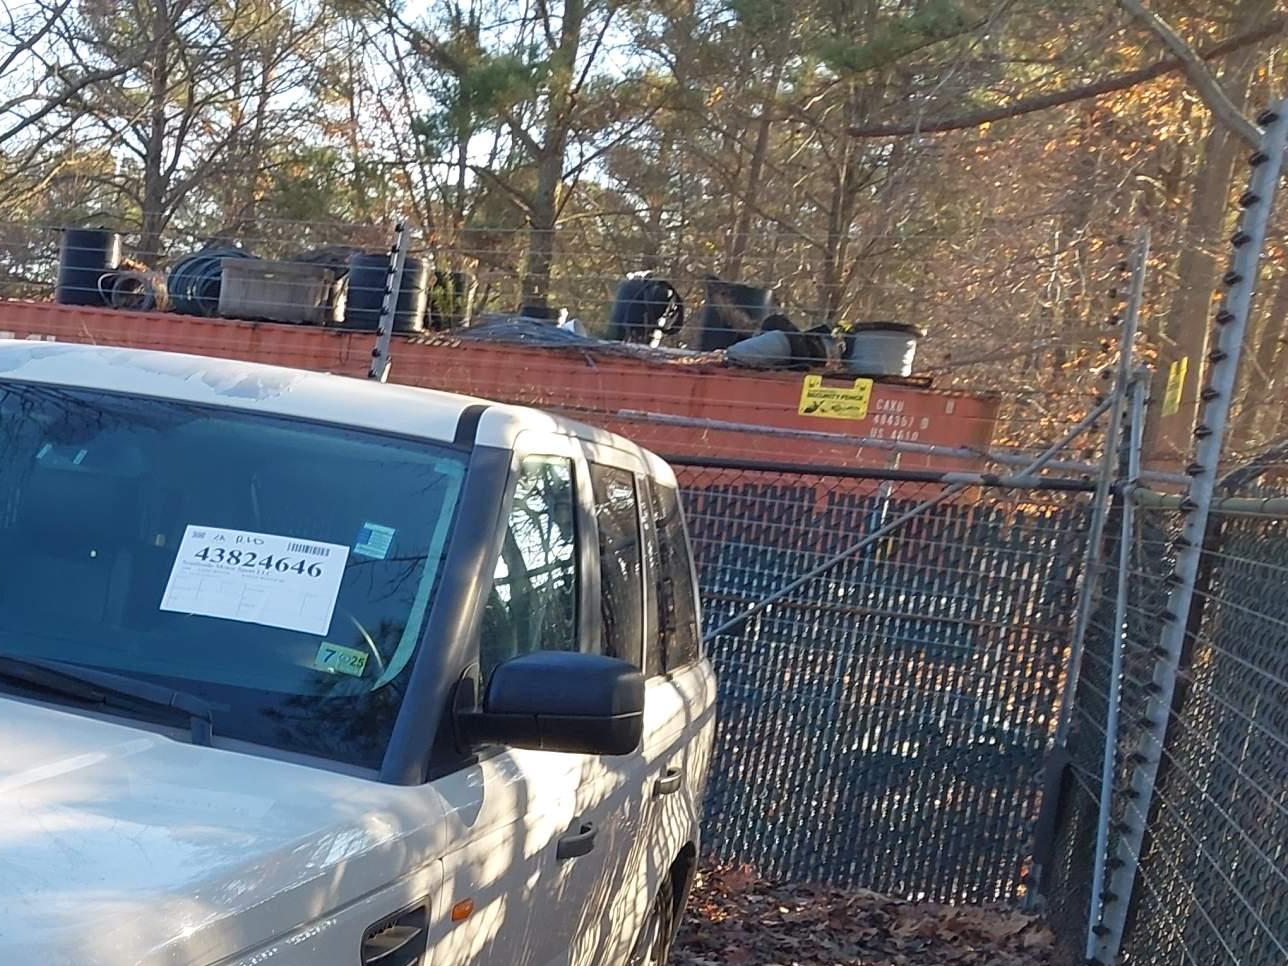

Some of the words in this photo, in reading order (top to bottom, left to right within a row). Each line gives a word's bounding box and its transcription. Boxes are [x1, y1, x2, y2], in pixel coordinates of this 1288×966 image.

[876, 398, 904, 412] CAXU
[194, 545, 323, 578] 43824646
[323, 648, 337, 663] 7
[349, 655, 365, 668] 25
